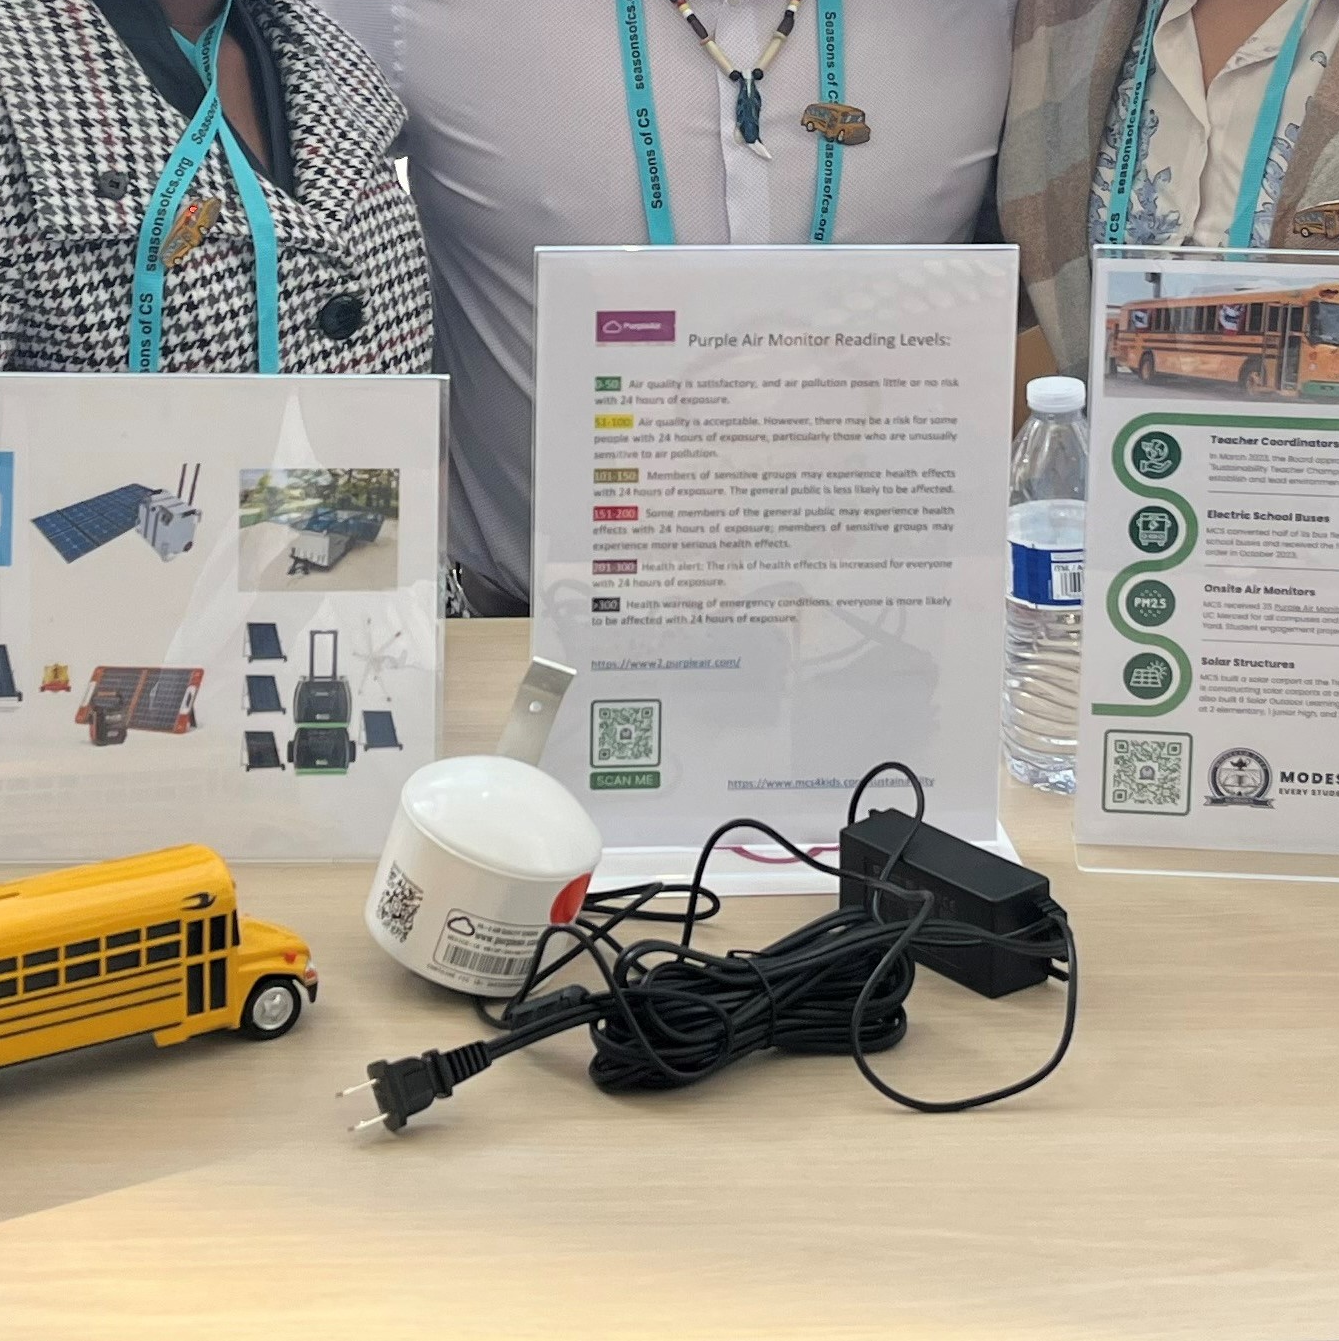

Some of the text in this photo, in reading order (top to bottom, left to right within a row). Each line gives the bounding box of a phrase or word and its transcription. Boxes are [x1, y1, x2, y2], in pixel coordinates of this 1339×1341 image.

[824, 11, 837, 68] Seasons
[826, 72, 838, 86] of
[1117, 81, 1142, 195] seasonsofcs.org
[636, 108, 663, 209] Seasons of CS
[145, 157, 193, 272] seasonsofcs.org
[1108, 212, 1120, 233] CS
[139, 292, 154, 315] CS
[138, 320, 152, 336] of
[688, 330, 951, 350] Purple Air Monitor Reading Levels:
[1210, 433, 1339, 449] Teacher Coordinators
[1207, 507, 1330, 523] Electric School Buses
[1204, 581, 1316, 596] Onsite Air Monitors
[1133, 596, 1168, 610] PM2.5
[1200, 654, 1295, 669] Solar Structures
[596, 774, 654, 786] SCAN ME
